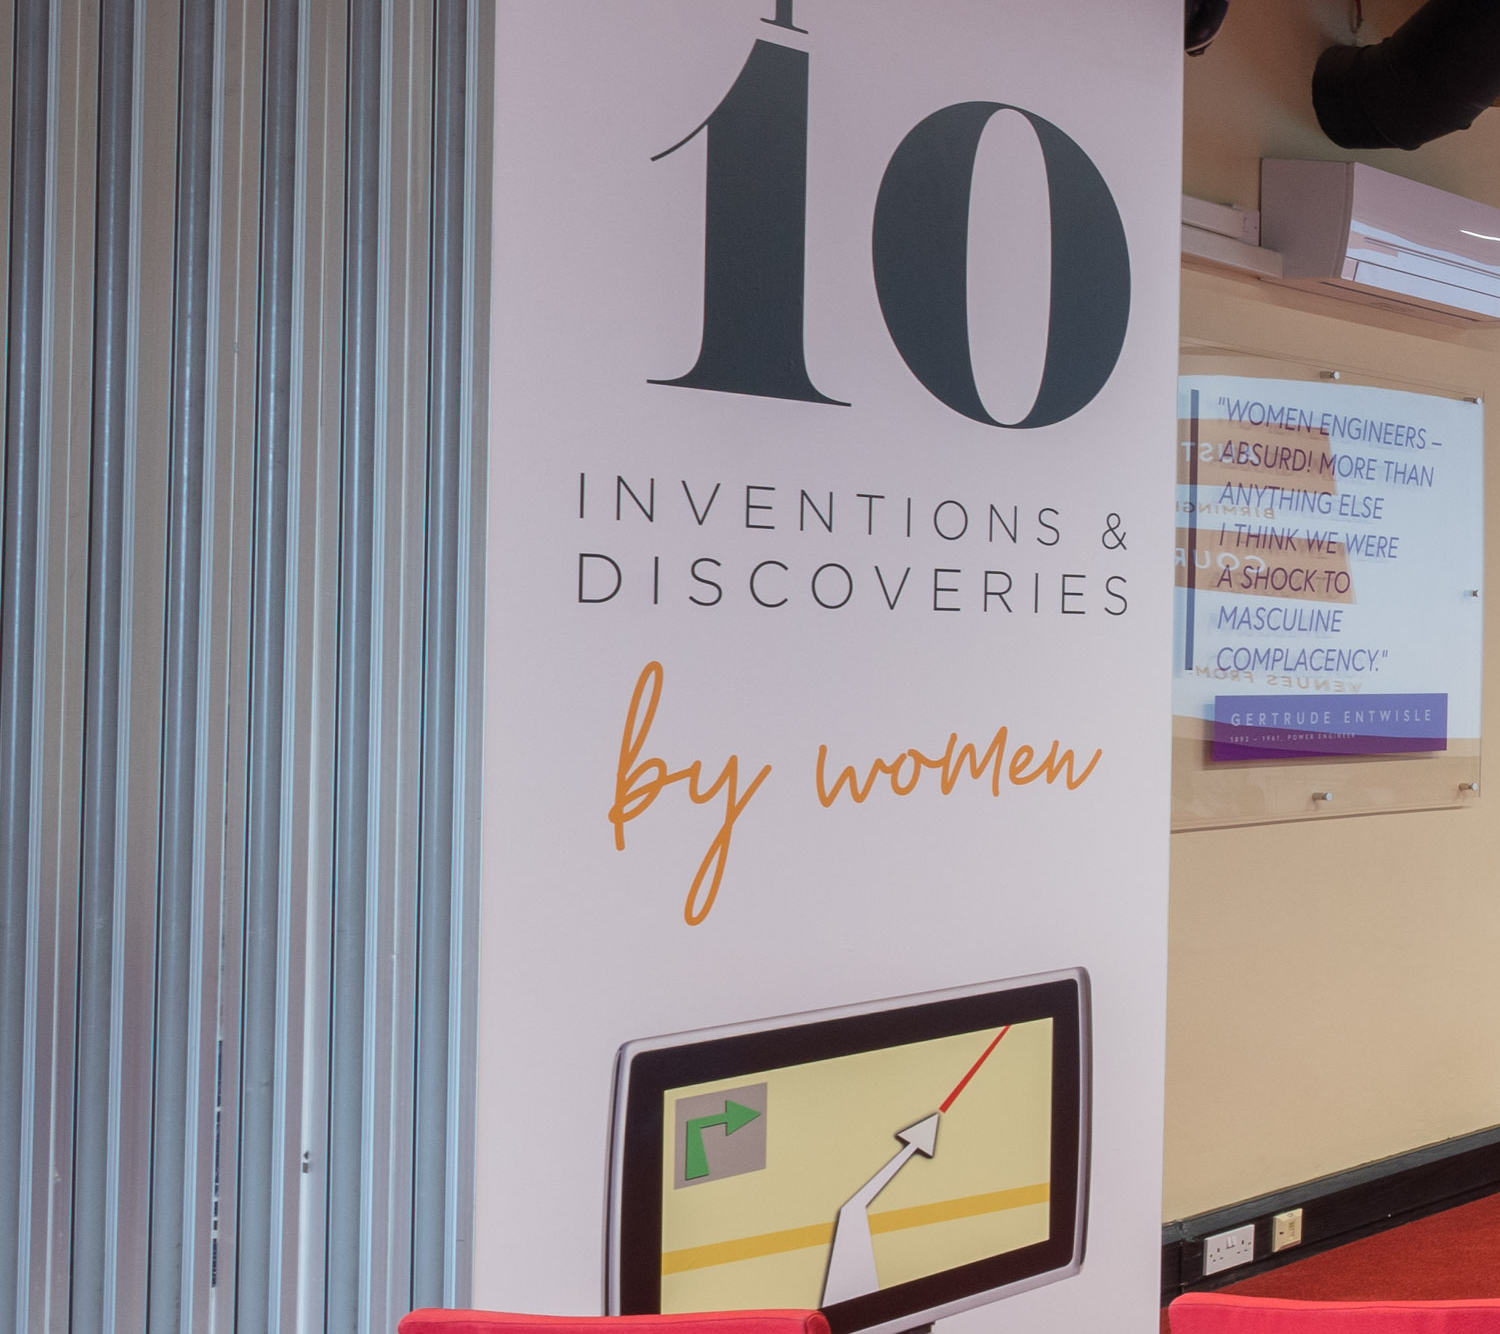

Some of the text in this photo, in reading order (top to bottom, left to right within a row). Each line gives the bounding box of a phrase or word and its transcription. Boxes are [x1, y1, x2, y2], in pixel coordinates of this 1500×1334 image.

[645, 38, 1134, 430] 10
[1218, 396, 1427, 449] "WOMEN ENGINEERS
[1219, 440, 1313, 473] ABSURD!
[1319, 452, 1378, 481] MORE
[1384, 460, 1434, 488] THAN
[578, 470, 1131, 553] INVENTIONS &
[1218, 481, 1332, 515] ANYTHING
[1338, 494, 1385, 519] ELSE
[1219, 522, 1399, 558] I THINK WE WERE
[577, 550, 1131, 619] DISCOVERIES
[1216, 564, 1351, 594] A SHOCK TO
[1217, 605, 1344, 632] MASCULINE
[1216, 647, 1388, 672] COMPLACENCY."
[1230, 709, 1432, 727] GERTRUDE ENTWISLE
[1287, 733, 1314, 741] POWER
[1317, 732, 1356, 740] ENGINEER
[608, 660, 1101, 927] by women
